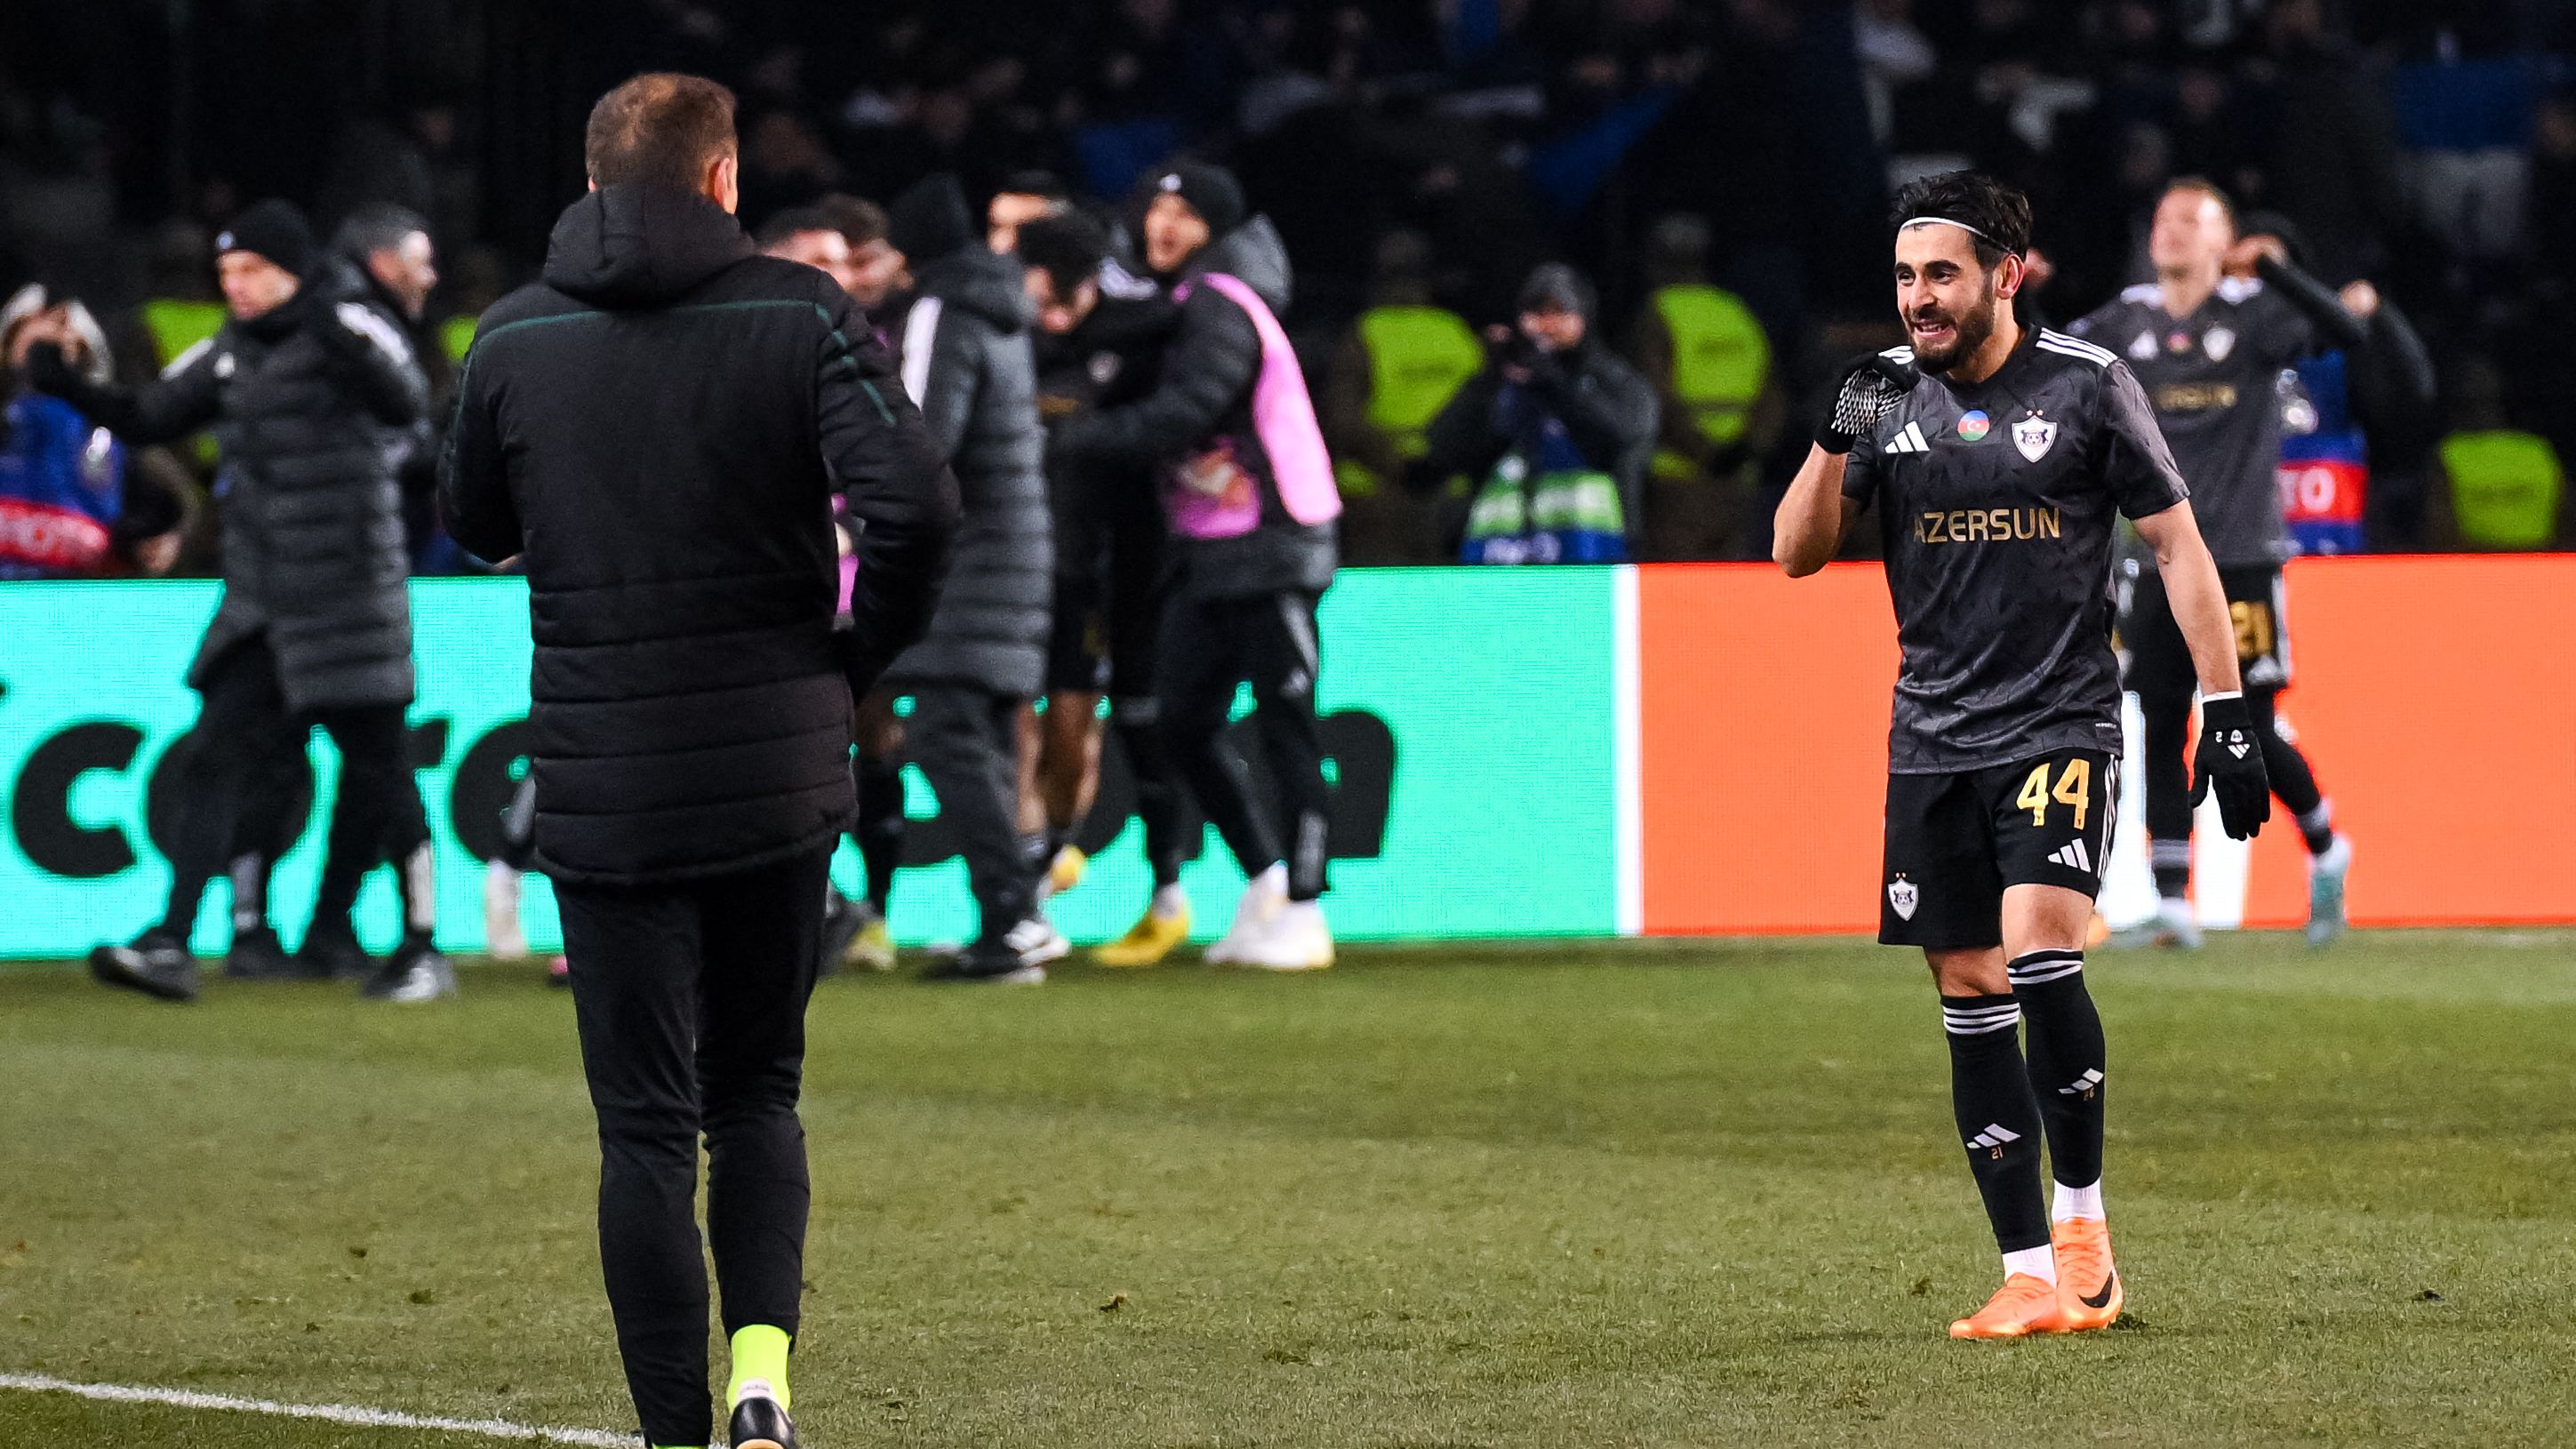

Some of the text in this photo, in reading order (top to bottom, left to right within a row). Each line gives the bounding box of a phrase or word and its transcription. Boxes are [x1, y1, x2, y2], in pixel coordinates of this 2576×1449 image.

[1914, 508, 2060, 544] AZERSUN
[2016, 757, 2090, 830] 44
[1991, 1146, 2004, 1160] 21
